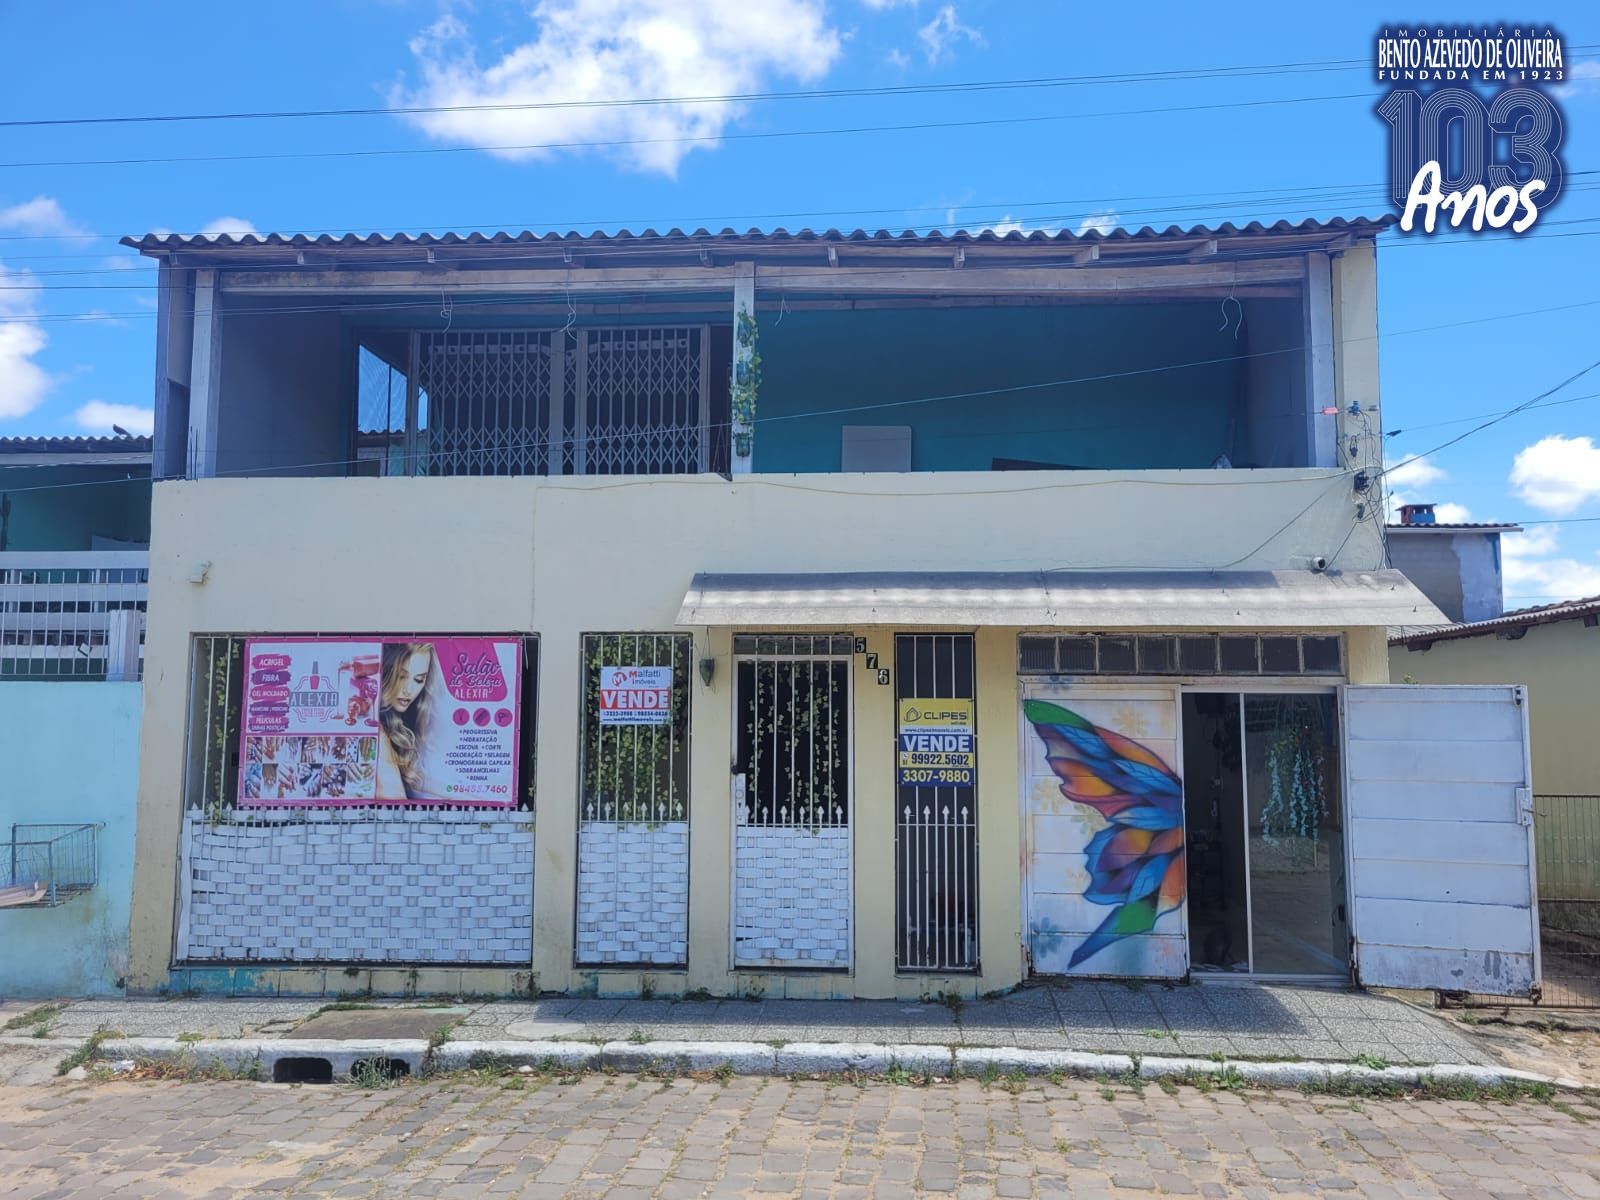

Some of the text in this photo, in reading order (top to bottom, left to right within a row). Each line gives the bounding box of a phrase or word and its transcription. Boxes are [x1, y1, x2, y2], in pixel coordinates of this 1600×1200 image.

[262, 673, 280, 682] FIBRA
[629, 669, 661, 678] Malfatti
[602, 690, 669, 709] VENDE
[923, 711, 967, 721] CLIPES
[903, 735, 970, 752] VENDE
[911, 753, 970, 766] 99922.5602
[902, 769, 970, 783] 3307-9880
